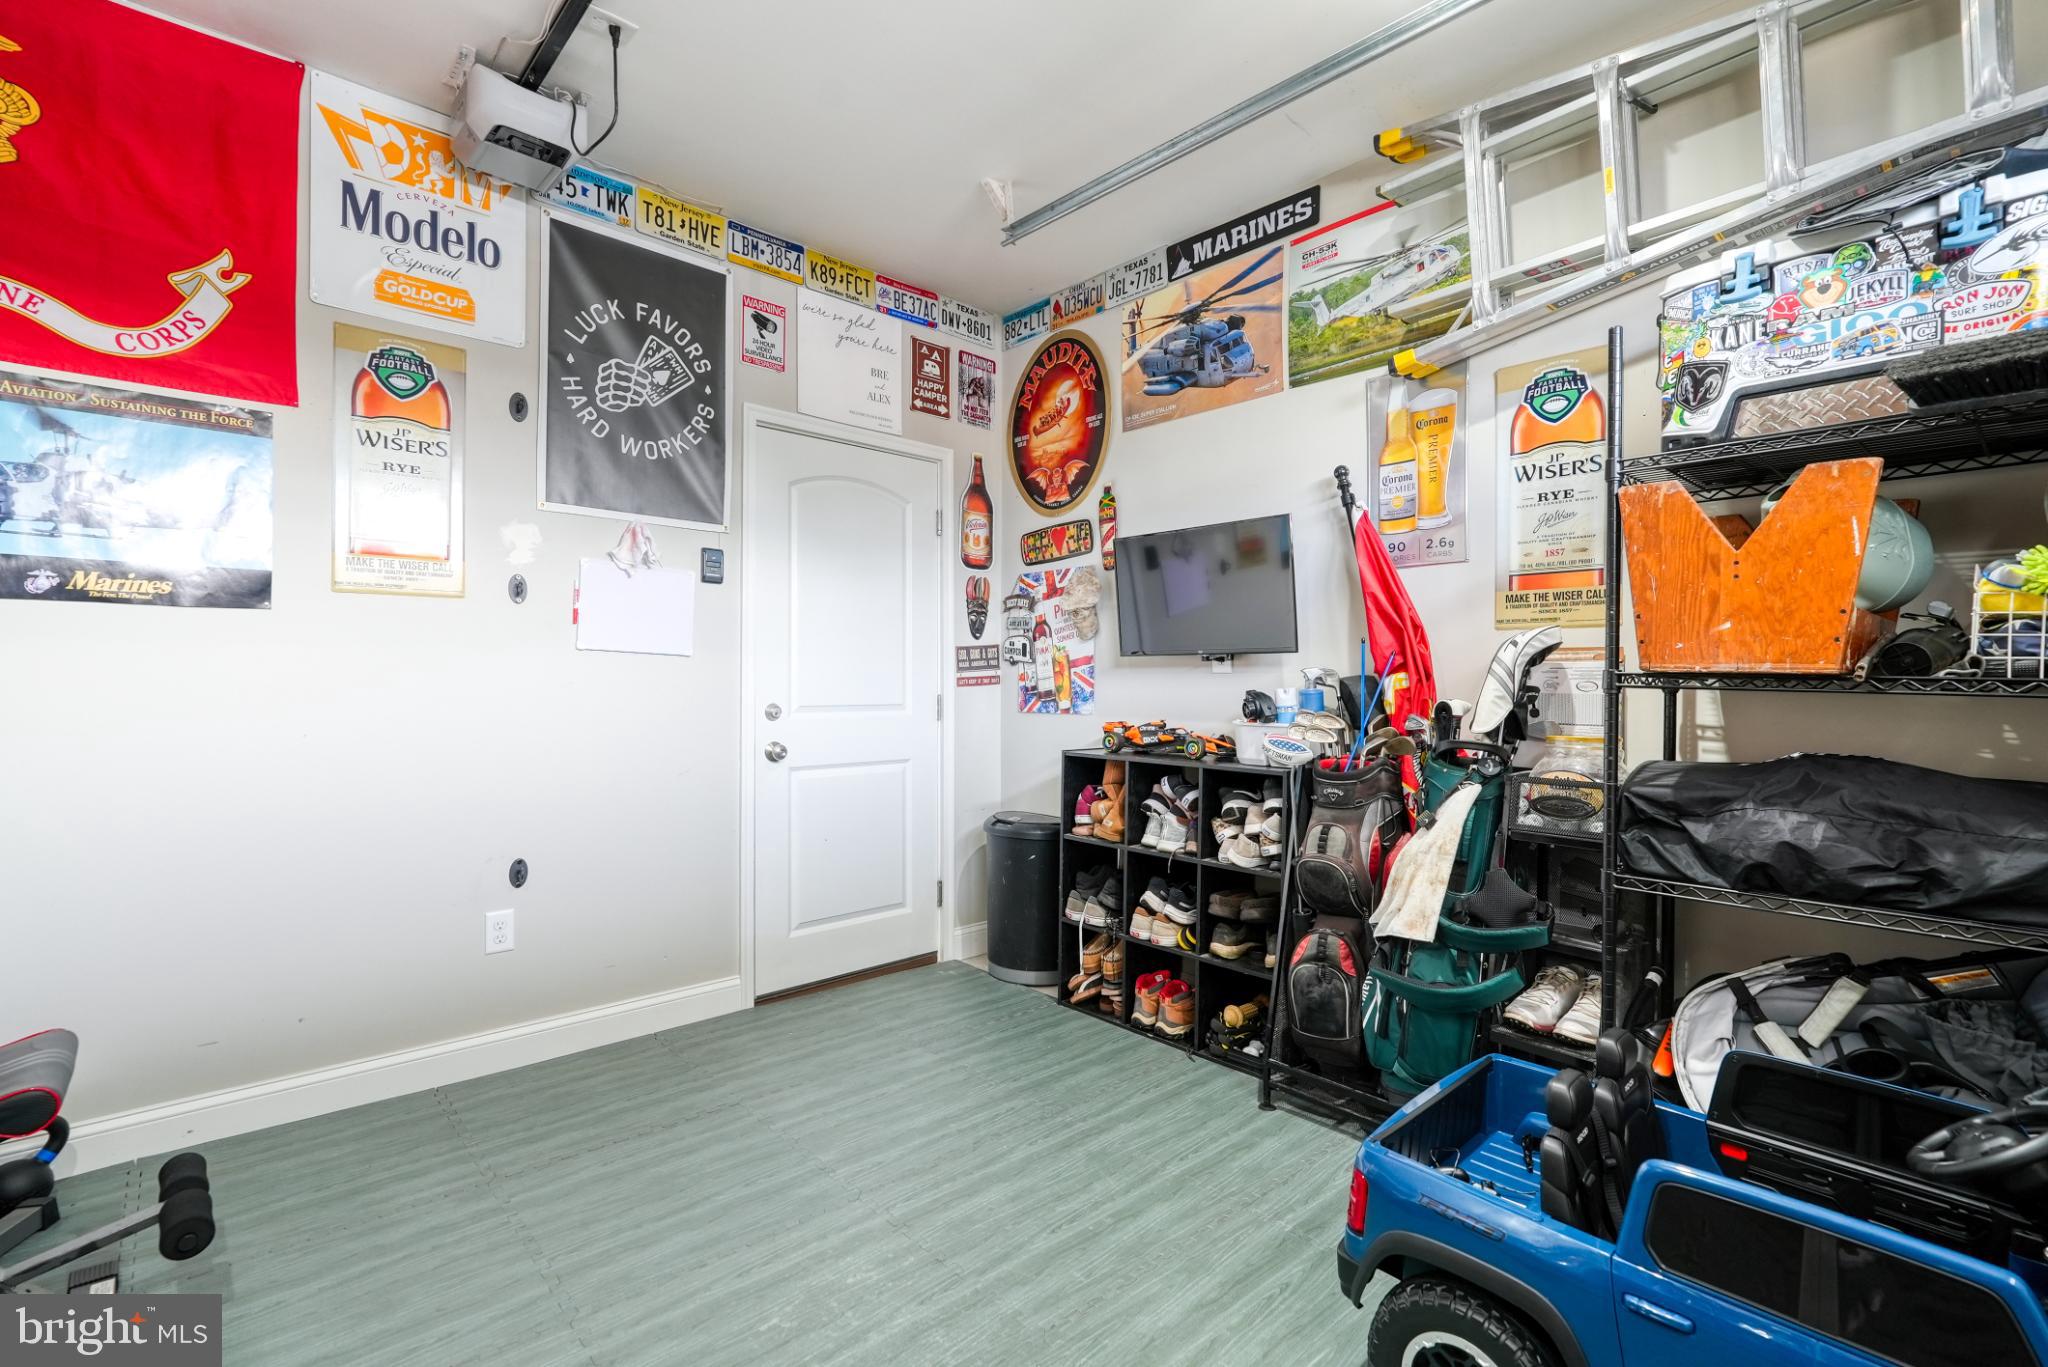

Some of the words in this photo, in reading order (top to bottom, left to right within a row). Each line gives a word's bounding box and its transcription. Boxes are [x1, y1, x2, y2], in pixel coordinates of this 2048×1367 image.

[396, 192, 455, 217] CERVEZA
[594, 183, 629, 217] TWK
[658, 195, 679, 209] New
[680, 202, 706, 219] Jersey
[340, 179, 502, 271] Modelo
[643, 200, 677, 233] T81
[688, 217, 721, 249] HVE
[1192, 196, 1313, 265] MARINES
[659, 230, 685, 245] Garden
[687, 239, 706, 252] State
[747, 229, 787, 247] PENNSYLVANIA
[732, 231, 759, 260] LBM
[766, 243, 801, 275] 3854
[1301, 242, 1337, 261] CH-53K
[380, 246, 463, 283] Especial
[823, 254, 839, 267] New
[839, 259, 859, 274] Jersey
[1123, 257, 1149, 273] TEXAS
[1557, 280, 1617, 307] GORILLA
[1639, 240, 1710, 272] LADDERS
[810, 261, 836, 287] K89
[846, 270, 871, 298] FCT
[1108, 278, 1129, 301] JGL
[1135, 262, 1164, 290] 7781
[1851, 276, 1905, 301] JEKYLL
[824, 285, 844, 297] Garden
[844, 291, 861, 303] State
[1943, 289, 1980, 310] RON
[1984, 285, 2026, 300] JON
[743, 296, 785, 318] WARNING
[893, 290, 937, 321] BE37AC
[956, 303, 979, 318] TEXAS
[1951, 305, 1978, 319] SURF
[1983, 298, 2013, 312] SHOP
[563, 299, 625, 345] LUCK
[801, 303, 831, 319] we're
[832, 313, 846, 321] so
[844, 314, 876, 333] glad
[1005, 319, 1022, 341] 882
[1029, 308, 1048, 332] LTL
[114, 310, 207, 352] CORPS
[635, 302, 713, 375] FAVORS
[966, 317, 992, 342] 8601
[755, 345, 773, 354] VIDEO
[760, 340, 776, 350] HOUR
[872, 337, 898, 356] here
[384, 354, 421, 365] FANTASY
[743, 355, 752, 363] NO
[752, 357, 784, 372] TRESPASSING
[744, 347, 783, 364] SURVEILLANCE
[961, 352, 995, 373] WARNING!
[372, 358, 431, 377] FOOTBALL
[870, 367, 889, 381] BRE
[1018, 342, 1098, 412] MAUDITE
[917, 378, 944, 393] HAPPY
[1528, 380, 1586, 398] FOOTBALL
[1538, 375, 1574, 388] FANTASY
[0, 379, 77, 403] AVIATION
[90, 392, 177, 419] SUSTAINING
[180, 409, 208, 423] THE
[211, 411, 255, 430] FORCE
[866, 392, 892, 405] ALEX
[913, 387, 948, 404] CAMPER
[560, 376, 610, 438] HARD
[393, 428, 412, 437] JP
[620, 403, 715, 460] WORKERS
[1415, 416, 1449, 430] Corona
[356, 428, 449, 458] WISER'S
[1427, 433, 1439, 484] PREMIER
[1546, 452, 1566, 464] JP
[382, 462, 422, 475] RYE
[1514, 454, 1604, 483] WISER'S
[1379, 482, 1417, 496] PREMIER
[1381, 473, 1413, 487] Corona
[1537, 488, 1575, 503] RYE
[1388, 541, 1406, 553] 90
[1425, 537, 1455, 549] 2.6g
[1426, 550, 1453, 559] CARBS
[1544, 548, 1566, 558] 1857
[345, 557, 375, 568] MAKE
[377, 559, 396, 569] THE
[399, 560, 429, 571] WISER
[431, 562, 454, 573] CALL
[65, 570, 174, 595] Marines
[1505, 593, 1531, 604] MAKE
[1533, 592, 1550, 602] THE
[1552, 590, 1583, 601] WISER
[987, 647, 998, 659] GUTS
[1004, 646, 1022, 657] CAMPER
